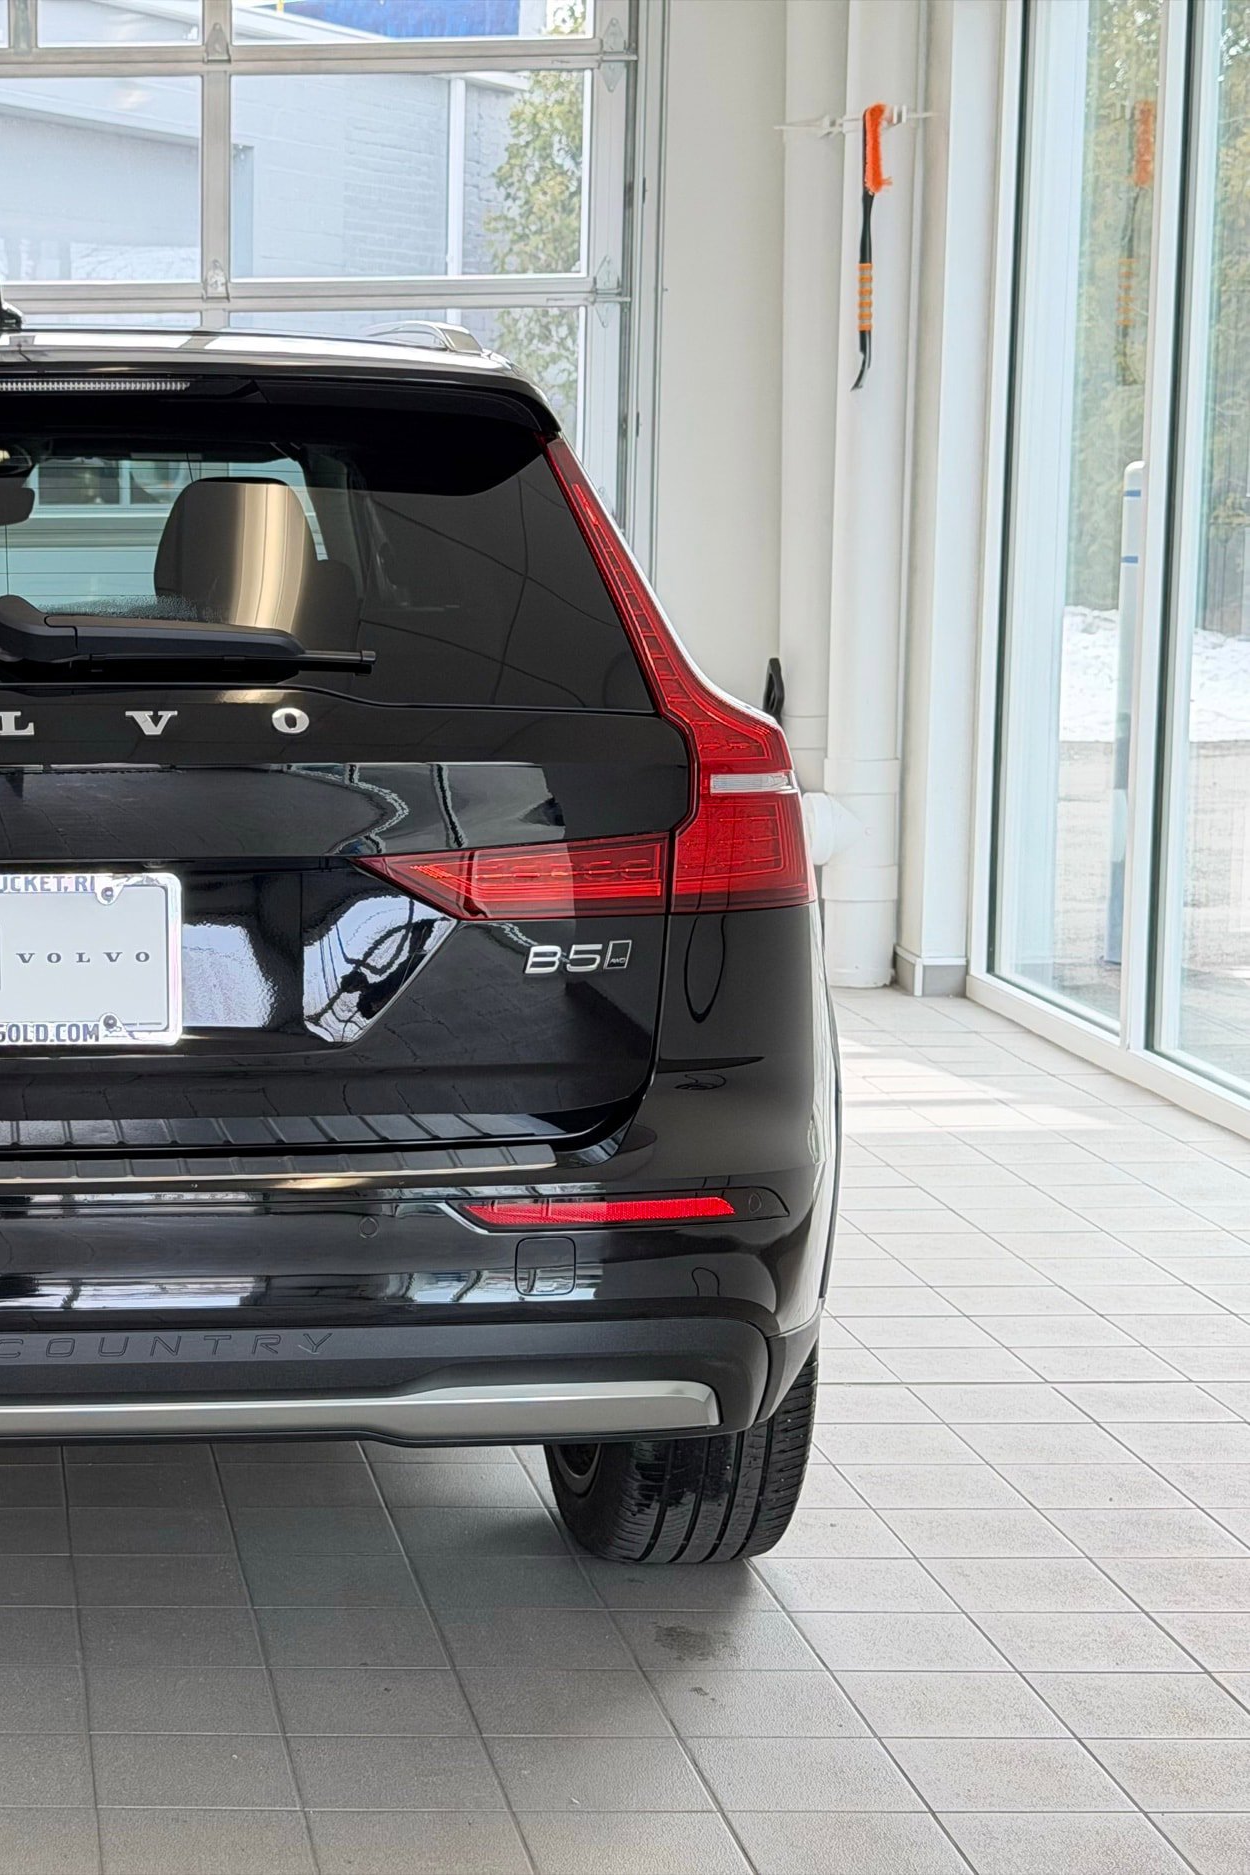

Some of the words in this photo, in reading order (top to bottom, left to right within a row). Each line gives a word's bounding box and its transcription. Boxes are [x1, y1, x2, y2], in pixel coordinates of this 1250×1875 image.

[74, 876, 95, 892] RI
[15, 951, 150, 964] VOLVO
[525, 944, 603, 974] B5
